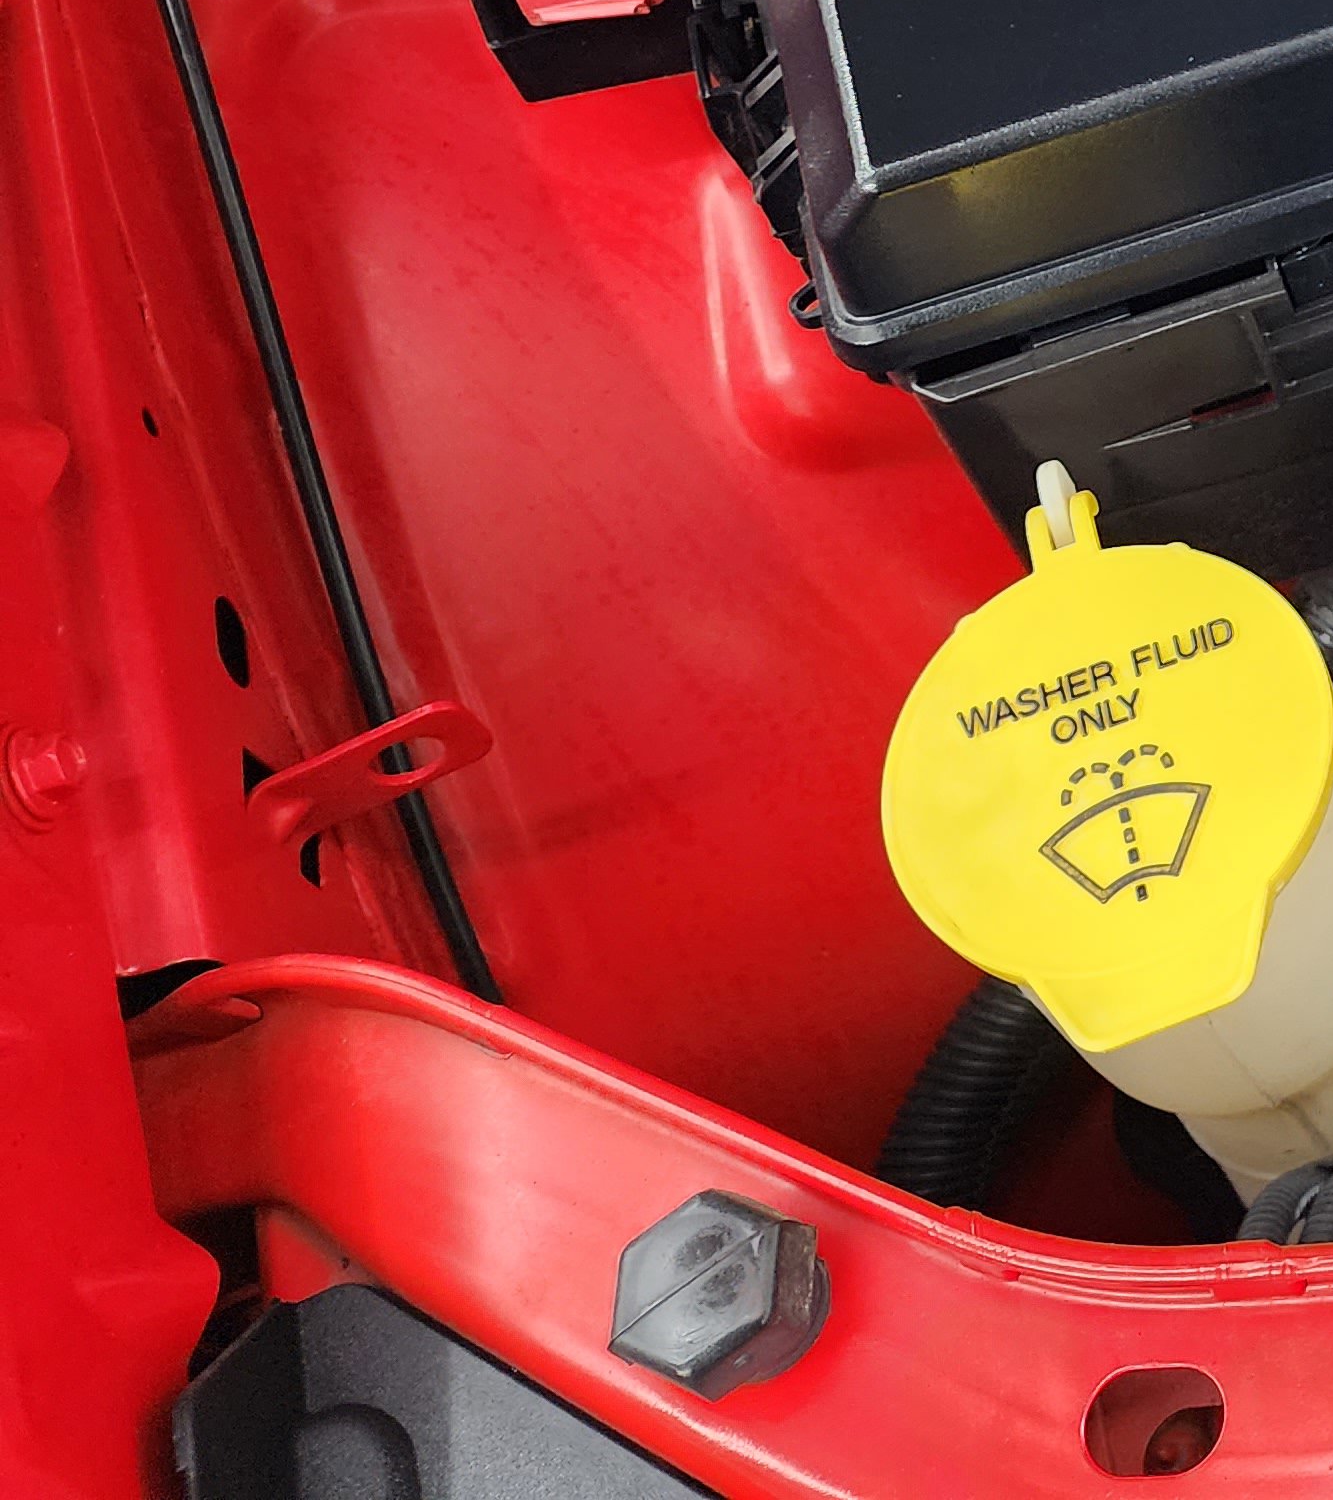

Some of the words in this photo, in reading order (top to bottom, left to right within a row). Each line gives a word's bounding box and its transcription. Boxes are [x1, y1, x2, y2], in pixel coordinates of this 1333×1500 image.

[957, 661, 1117, 738] WASHER
[1130, 618, 1234, 677] FLUID
[1051, 688, 1140, 744] ONLY
